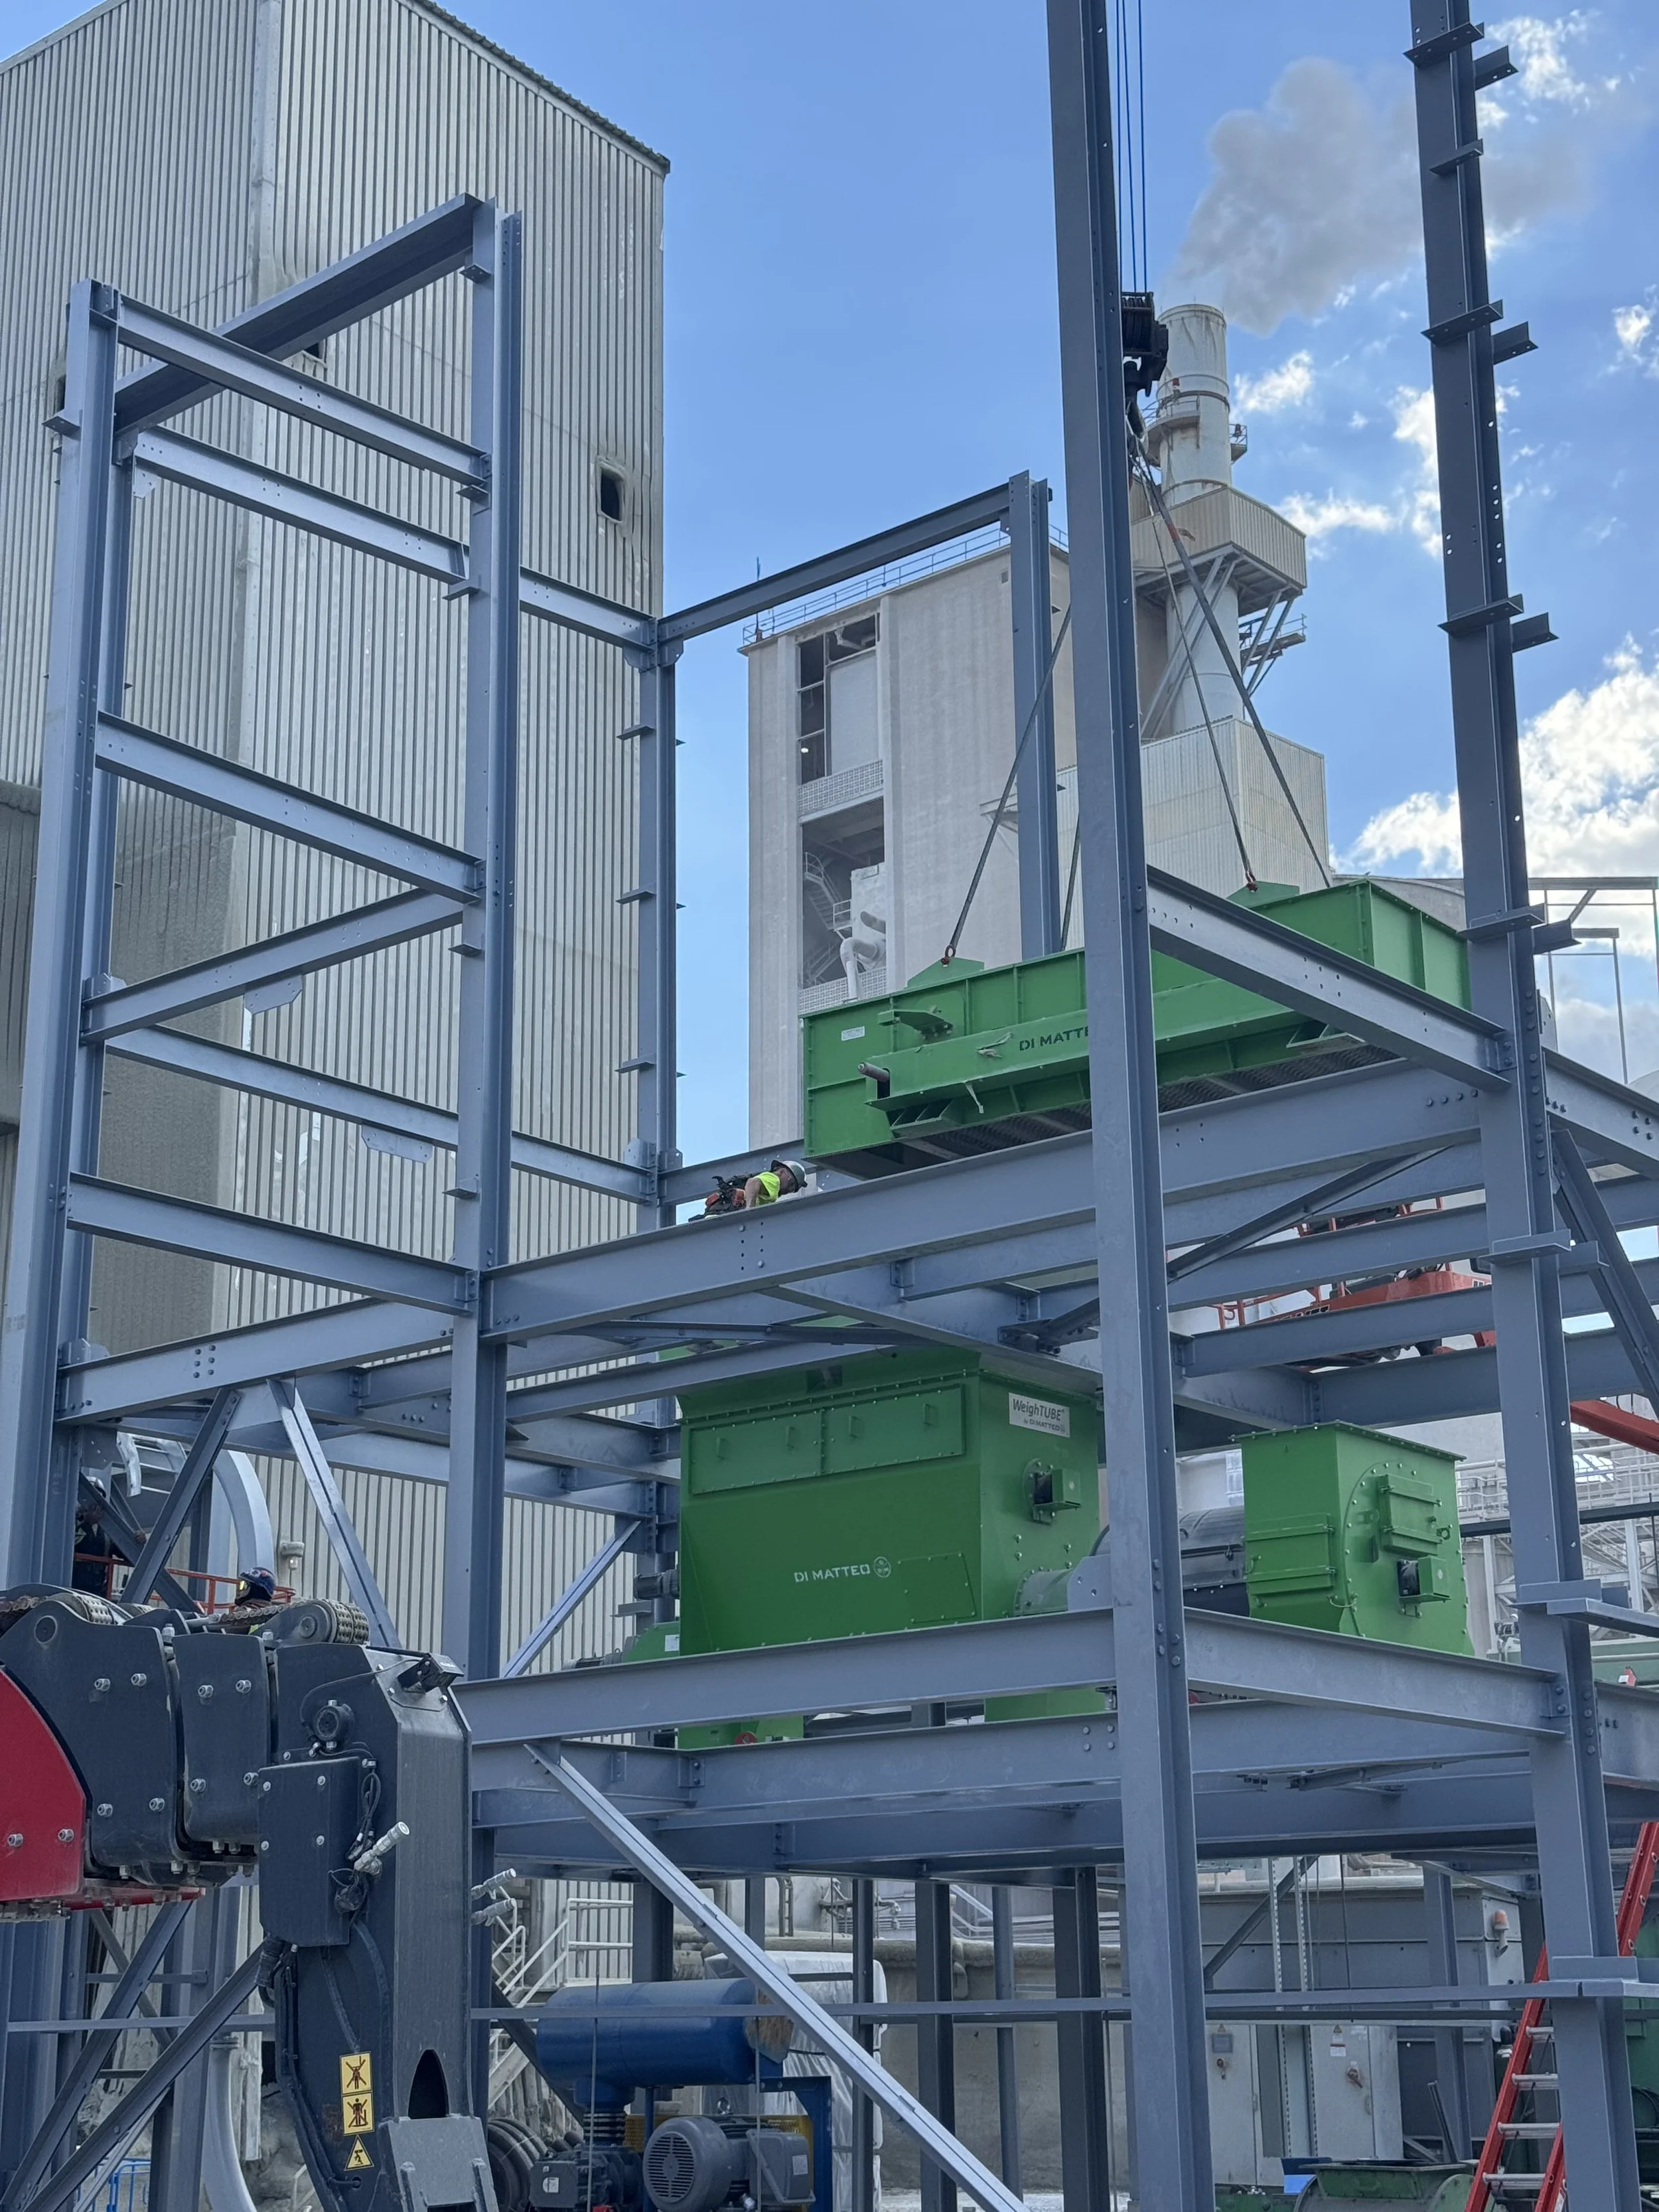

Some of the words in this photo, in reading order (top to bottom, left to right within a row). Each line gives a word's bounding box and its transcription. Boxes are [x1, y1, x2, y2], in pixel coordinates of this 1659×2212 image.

[1019, 1038, 1035, 1051] DI
[794, 1571, 808, 1583] DI
[812, 1564, 871, 1580] MATTEO
